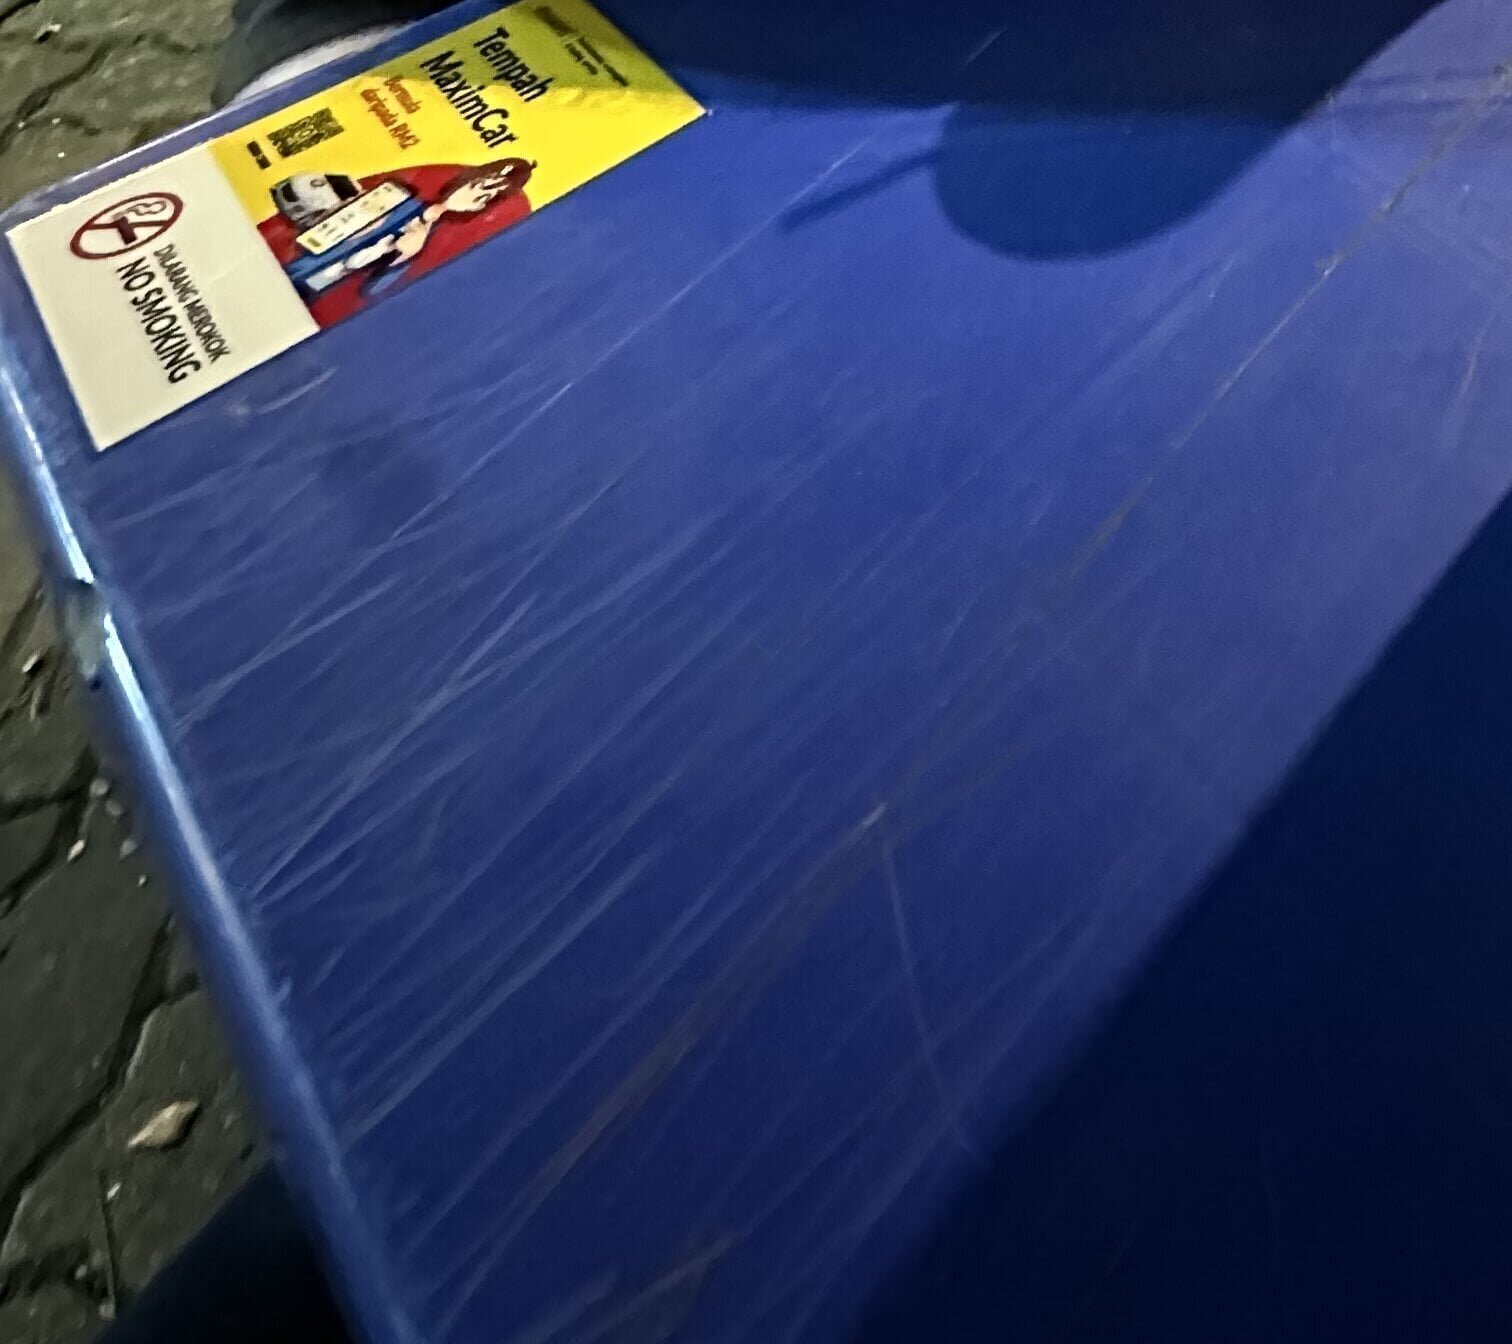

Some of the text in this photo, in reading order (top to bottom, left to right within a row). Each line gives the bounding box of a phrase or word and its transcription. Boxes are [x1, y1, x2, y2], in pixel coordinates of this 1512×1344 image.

[419, 49, 520, 150] MaximCar
[473, 25, 555, 104] Tempah
[115, 255, 204, 386] NO SMOKING
[153, 243, 232, 365] DILARANG MEROKOK
